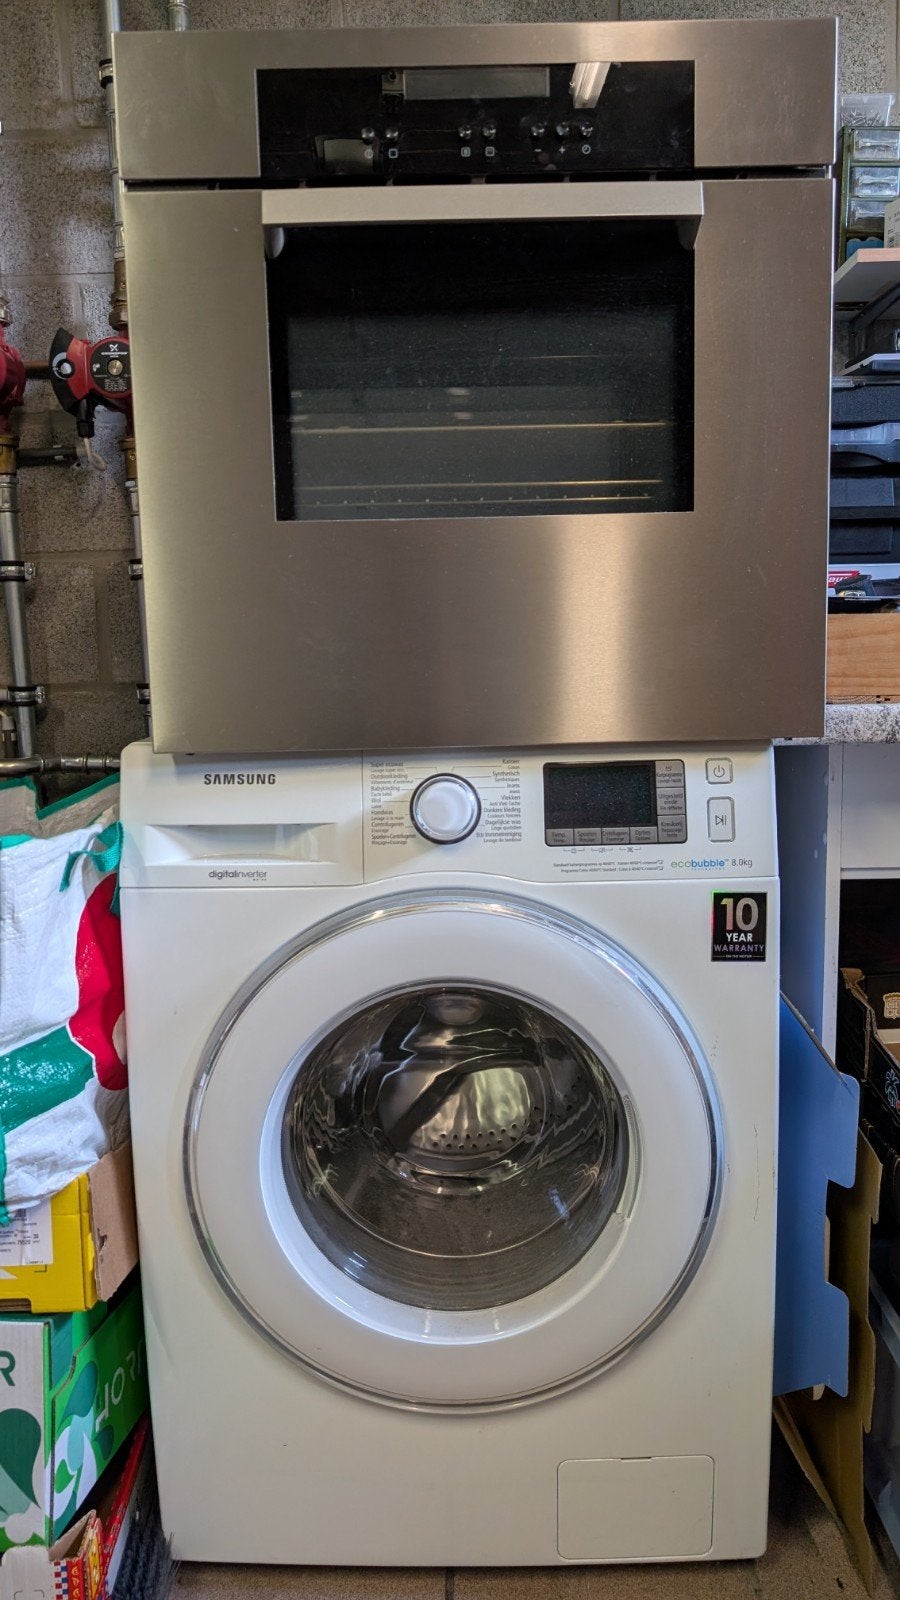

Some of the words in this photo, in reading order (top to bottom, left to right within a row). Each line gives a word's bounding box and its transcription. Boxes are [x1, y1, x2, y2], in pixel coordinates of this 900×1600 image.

[204, 774, 276, 785] SAMSUNG
[671, 859, 725, 868] ecobubble
[731, 858, 753, 869] 8.0kg
[208, 870, 268, 881] digitalinverter
[720, 897, 759, 931] 10
[726, 932, 753, 942] YEAR
[713, 944, 764, 952] WARRANTY
